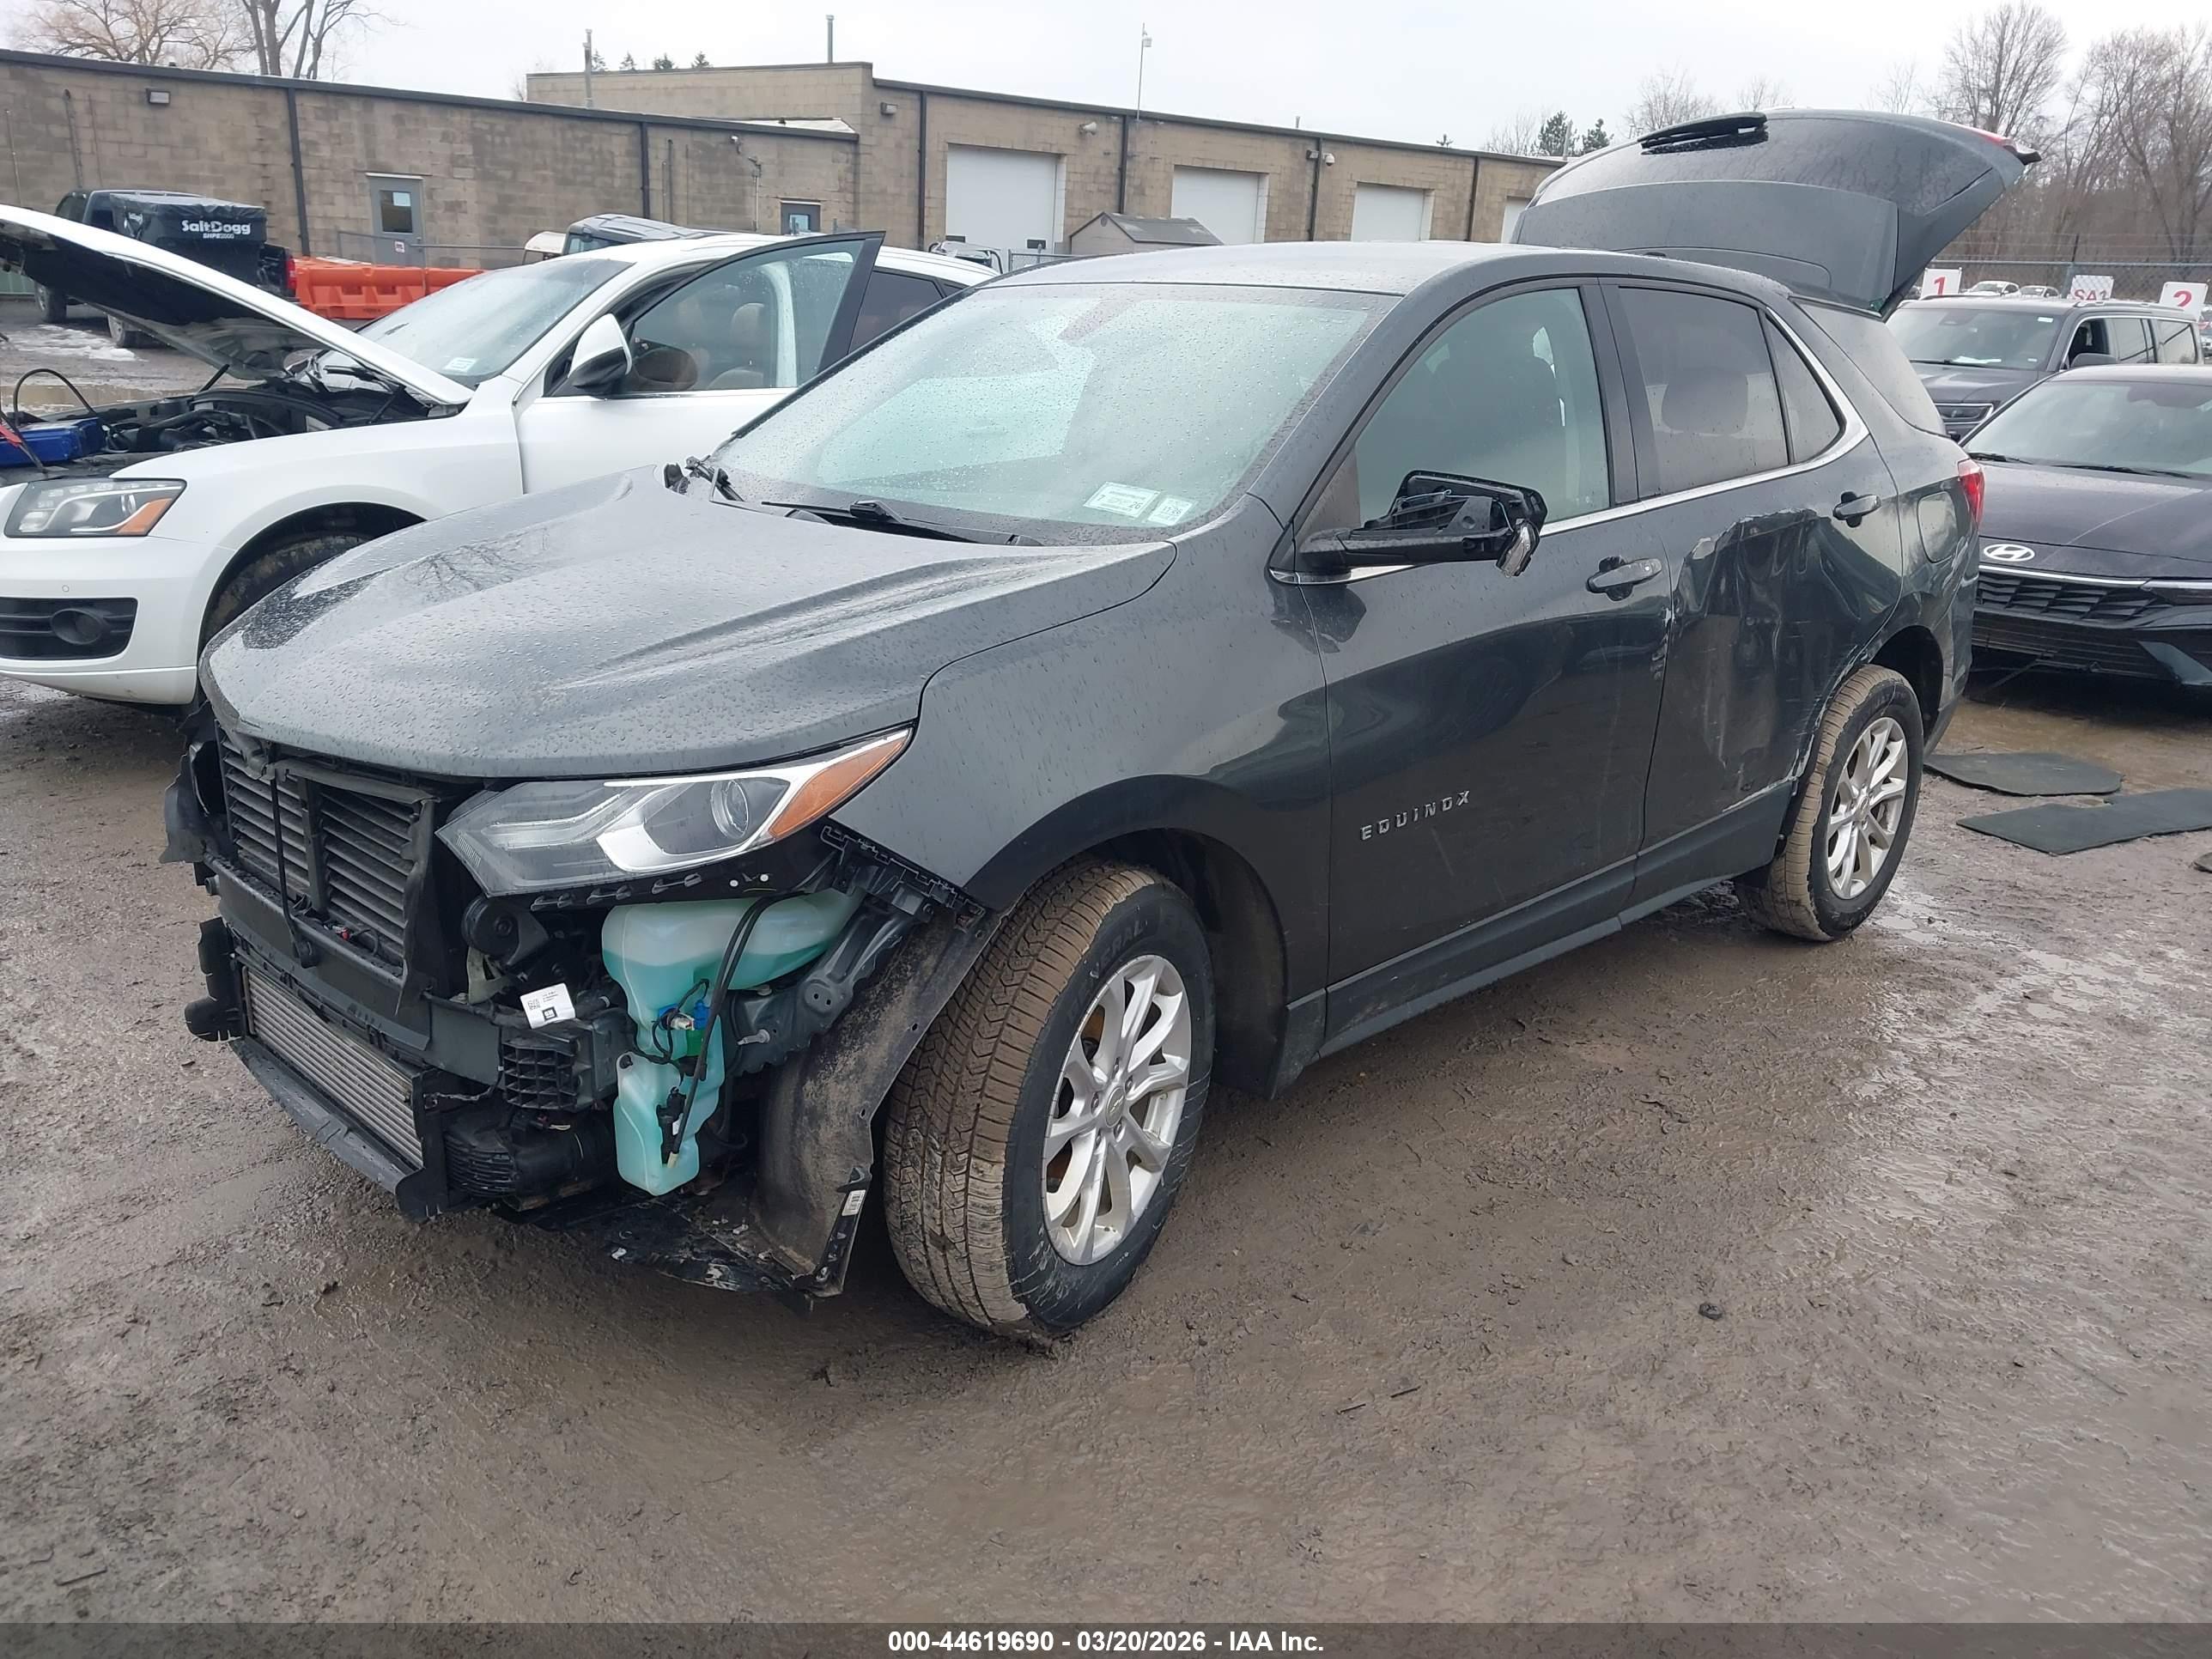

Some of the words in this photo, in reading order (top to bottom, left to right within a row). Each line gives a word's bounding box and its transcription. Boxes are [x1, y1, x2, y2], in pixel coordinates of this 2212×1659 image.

[181, 220, 252, 235] SaltDogg
[1934, 276, 1946, 295] 1
[1361, 790, 1470, 841] EQUINOX
